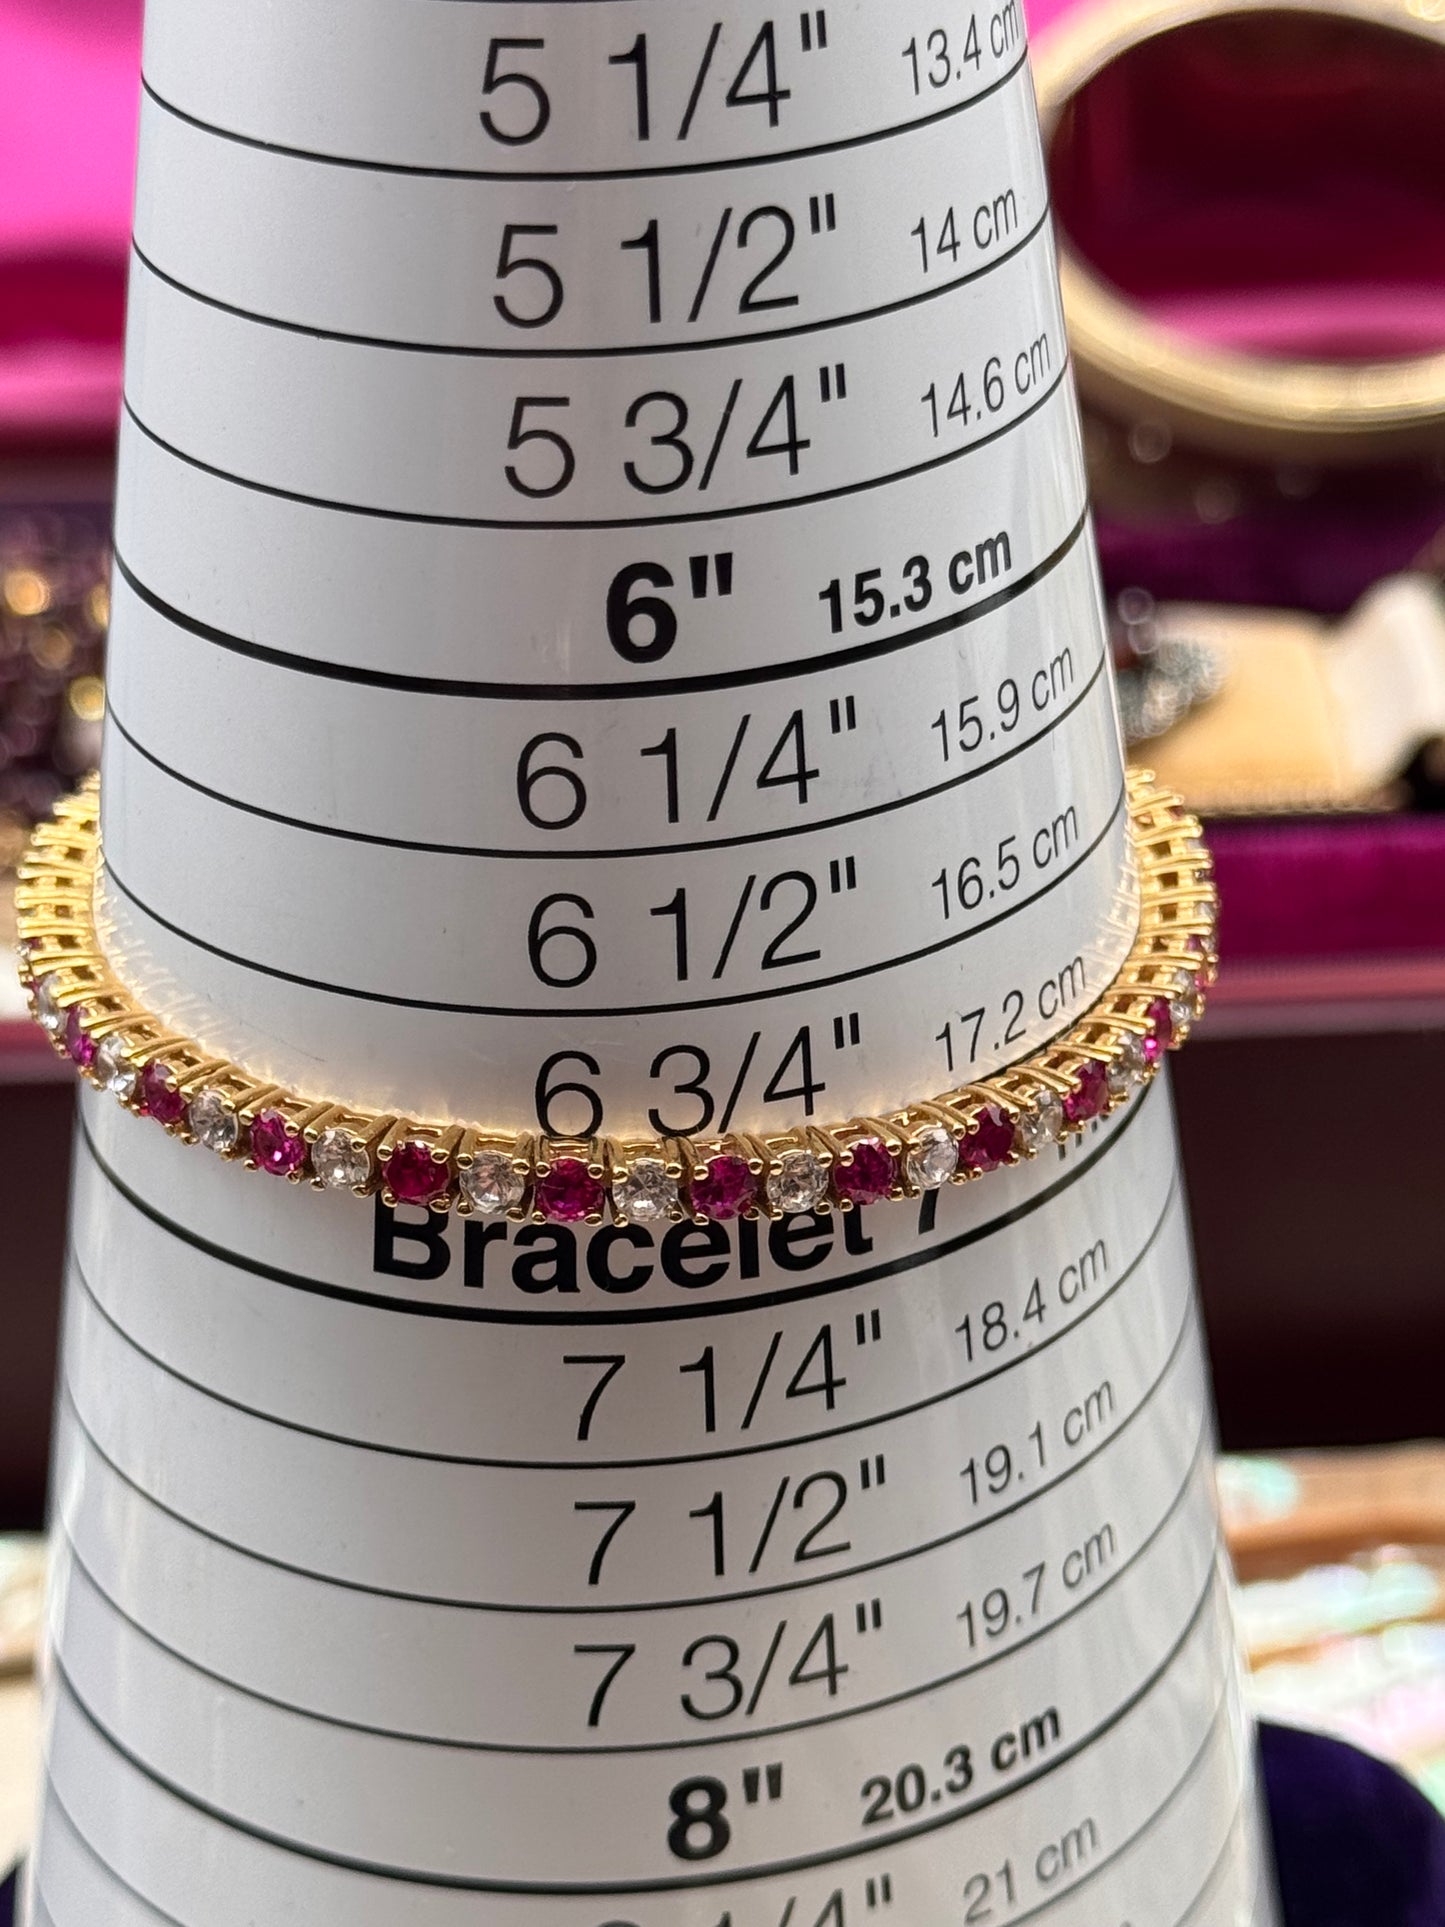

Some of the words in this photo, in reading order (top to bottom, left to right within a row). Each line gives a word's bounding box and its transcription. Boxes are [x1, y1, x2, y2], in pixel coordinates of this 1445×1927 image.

[479, 38, 550, 146] 5
[608, 9, 827, 141] 1/4"
[902, 13, 982, 95] 13.4
[990, 0, 1019, 58] cm
[493, 224, 564, 329] 5
[621, 193, 836, 323] 1/2"
[911, 206, 961, 273] 14
[973, 189, 1017, 250] cm
[504, 396, 575, 499] 5
[624, 363, 846, 495] 3/4"
[921, 357, 1004, 438] 14.6
[1015, 333, 1050, 395] cm
[606, 552, 733, 664] 6"
[819, 555, 932, 634] 15.3
[948, 531, 1012, 595] cm
[517, 732, 587, 830] 6
[640, 695, 856, 823] 1/4"
[931, 678, 1020, 762] 15.9
[1032, 647, 1074, 711] cm
[528, 893, 597, 988] 6
[650, 855, 856, 981] 1/2"
[932, 835, 1020, 920] 16.5
[1033, 805, 1079, 869] cm
[535, 1050, 603, 1138] 6
[648, 1012, 861, 1137] 3/4"
[936, 990, 1027, 1072] 17.2
[1038, 956, 1088, 1020] cm
[373, 1192, 873, 1293] Bracelet
[563, 1355, 625, 1441] 7
[680, 1309, 881, 1433] 1/4"
[955, 1277, 1046, 1362] 18.4
[1059, 1239, 1107, 1304] cm
[574, 1500, 636, 1586] 7
[689, 1454, 885, 1576] 1/2"
[960, 1421, 1045, 1505] 19.1
[1064, 1381, 1114, 1448] cm
[574, 1644, 636, 1728] 7
[681, 1598, 882, 1722] 3/4"
[957, 1561, 1045, 1648] 19.7
[1063, 1524, 1114, 1590] cm
[667, 1762, 783, 1863] 8"
[861, 1745, 974, 1827] 20.3
[991, 1706, 1061, 1773] cm
[964, 1860, 1015, 1926] 21
[1036, 1818, 1097, 1884] cm
